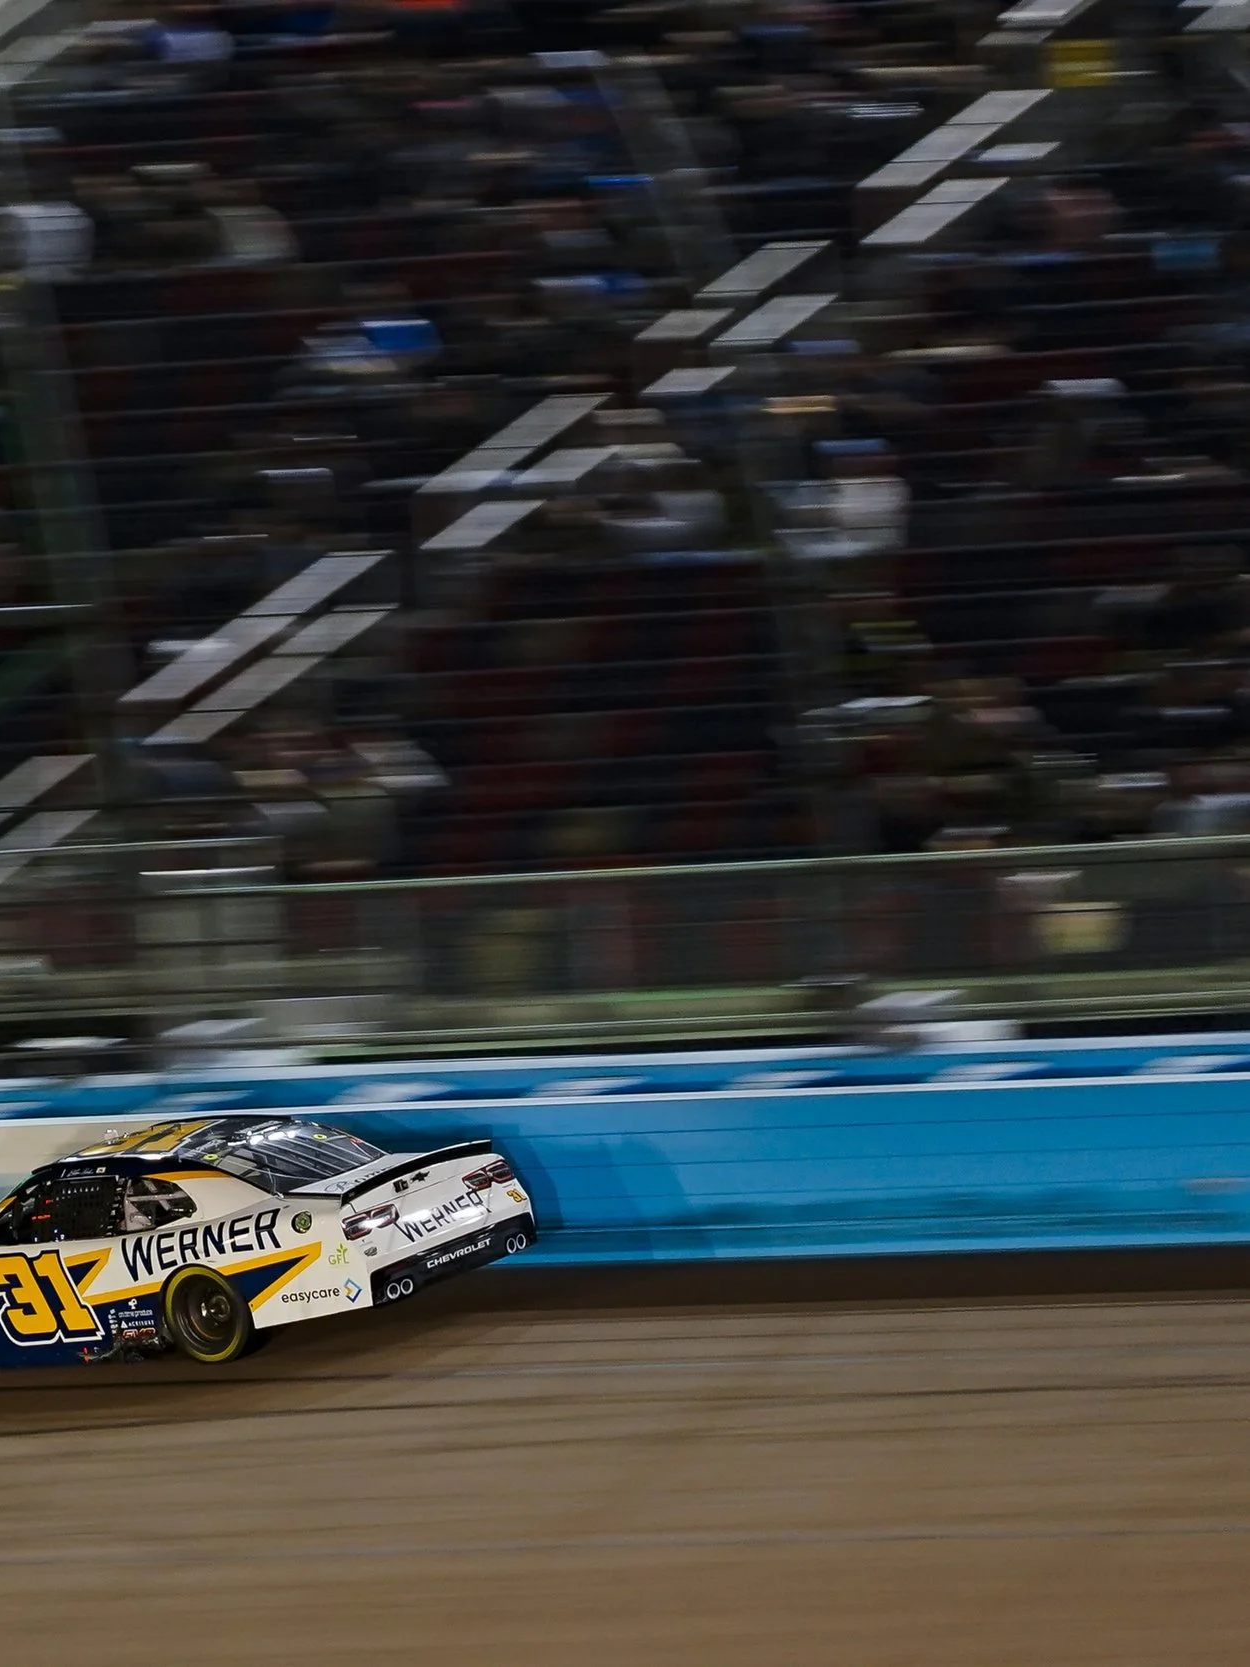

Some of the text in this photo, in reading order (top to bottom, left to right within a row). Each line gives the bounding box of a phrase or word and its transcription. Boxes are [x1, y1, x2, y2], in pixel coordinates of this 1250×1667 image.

[507, 1189, 527, 1202] 31
[394, 1190, 491, 1243] WERNER
[121, 1208, 281, 1282] WERNER
[427, 1238, 491, 1269] CHEVROLET
[328, 1251, 349, 1265] GFL
[281, 1287, 340, 1303] easycare
